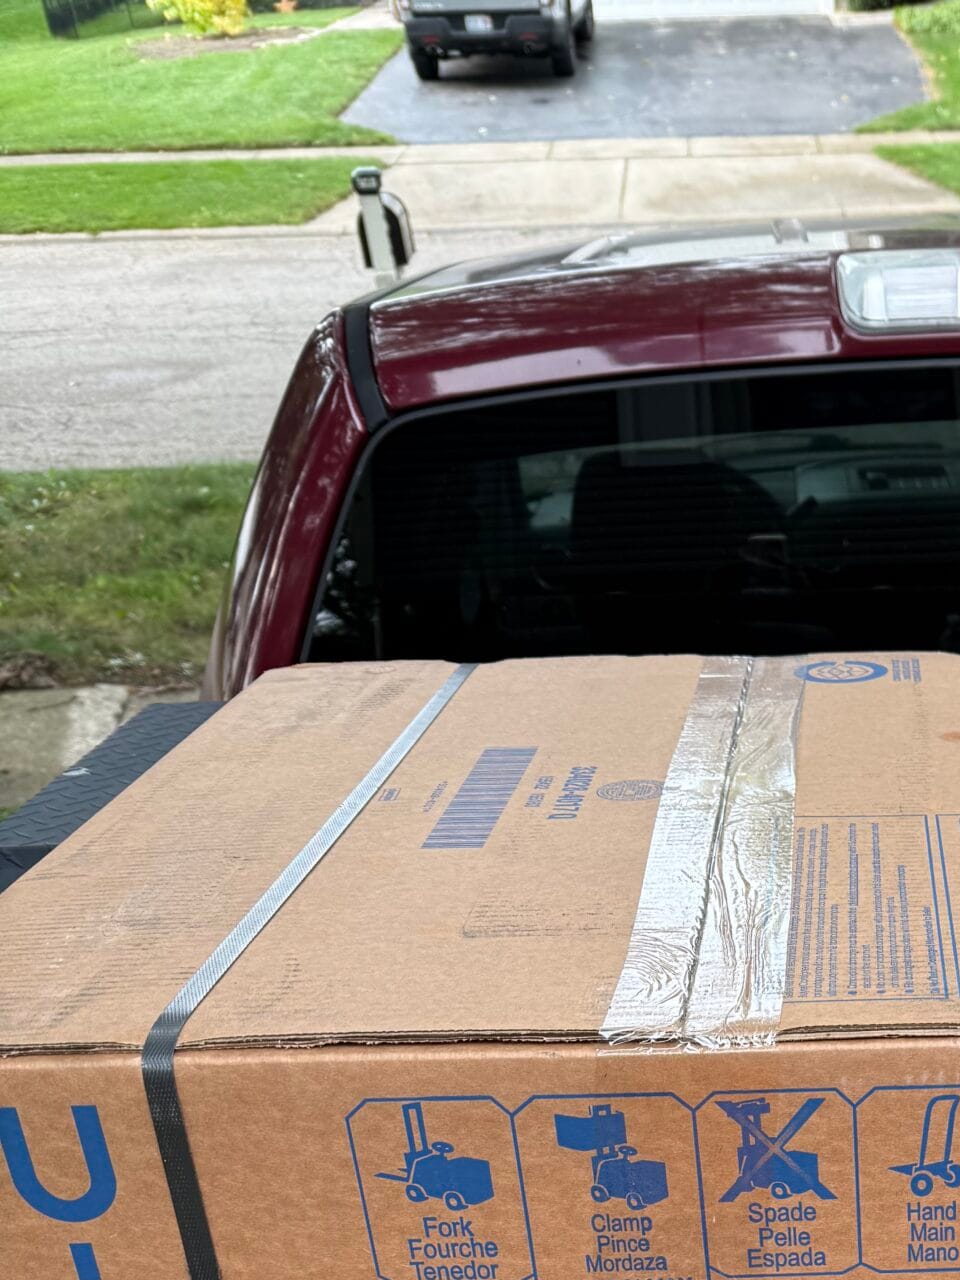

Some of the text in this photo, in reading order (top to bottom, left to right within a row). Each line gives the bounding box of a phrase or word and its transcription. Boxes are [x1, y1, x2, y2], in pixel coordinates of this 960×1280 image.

[747, 1201, 817, 1228] Spade
[906, 1200, 958, 1222] Hand
[422, 1216, 475, 1239] Fork
[590, 1213, 653, 1238] Clamp
[909, 1221, 956, 1242] Main
[597, 1233, 650, 1254] Pince
[757, 1226, 811, 1248] Pelle
[408, 1237, 499, 1261] Fourche
[747, 1246, 827, 1270] Espada
[906, 1241, 960, 1263] Mano
[586, 1251, 668, 1273] Mordaza
